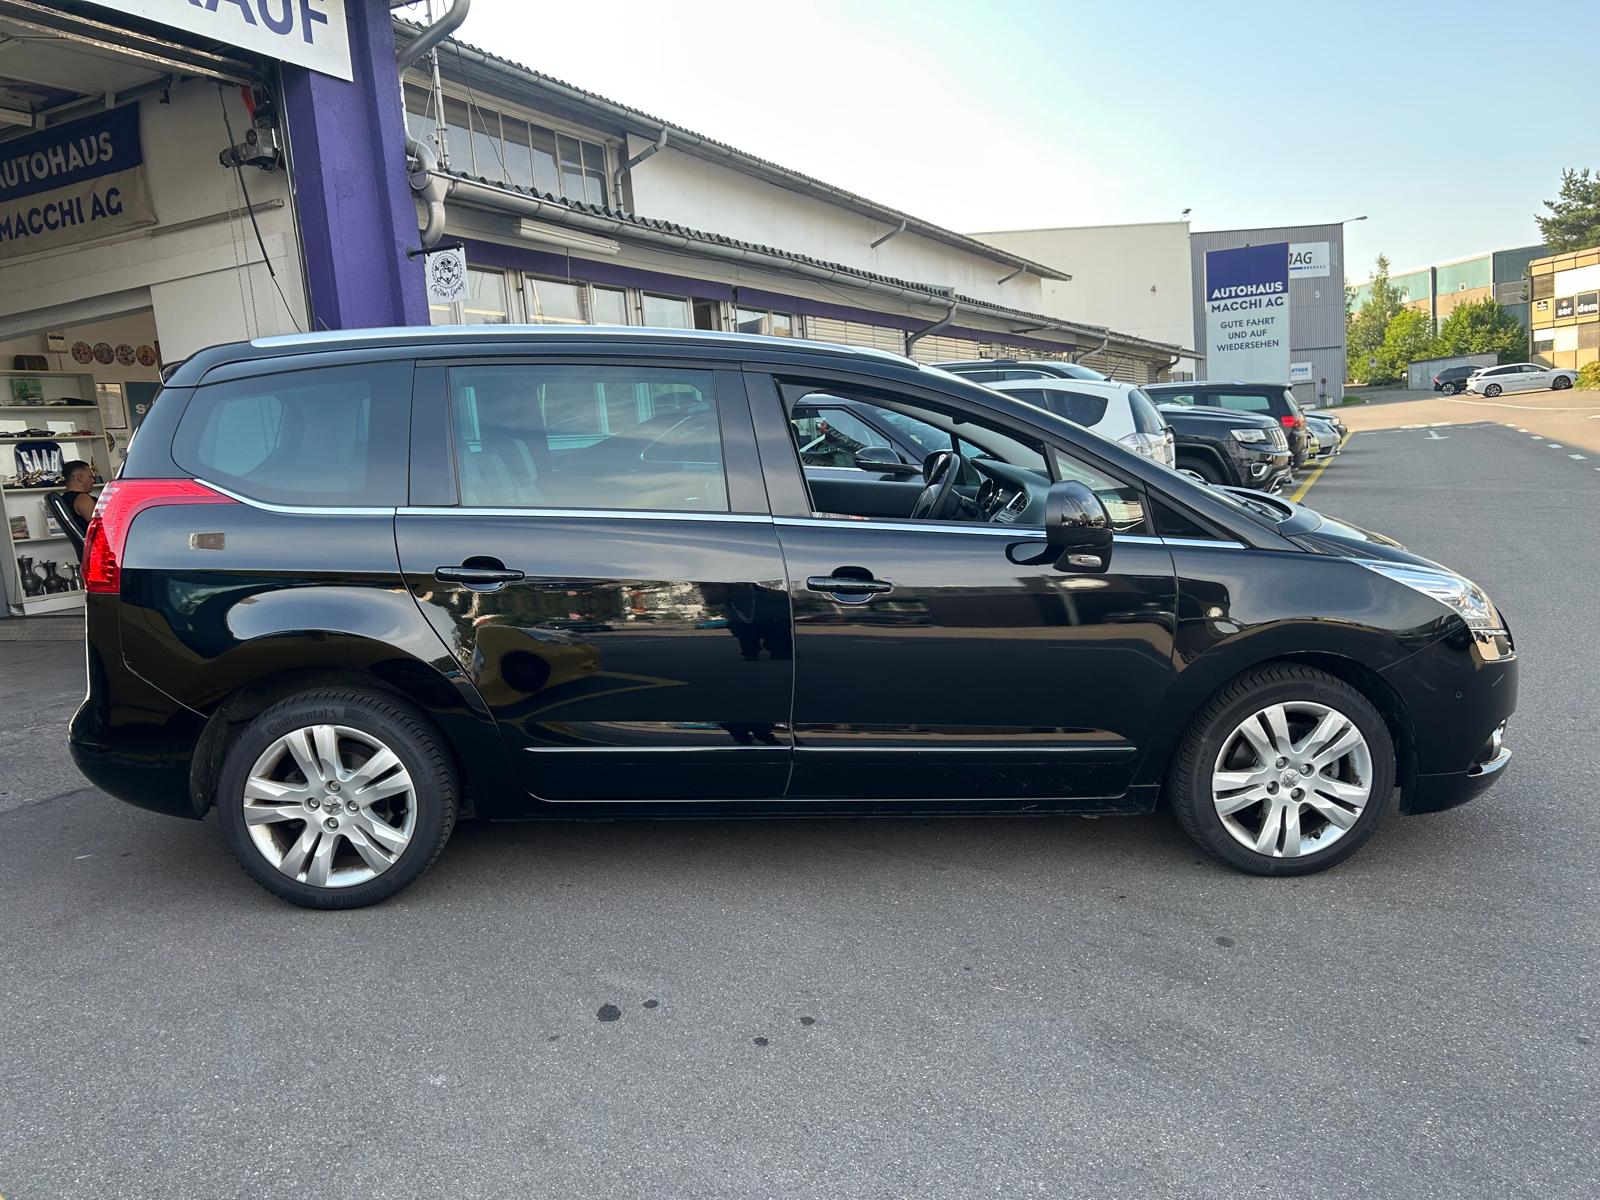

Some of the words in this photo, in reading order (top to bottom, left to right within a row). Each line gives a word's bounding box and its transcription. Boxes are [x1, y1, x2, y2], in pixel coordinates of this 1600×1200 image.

[188, 0, 328, 45] UF
[0, 197, 85, 241] MACCHI
[91, 187, 122, 221] AG
[1211, 281, 1283, 299] AUTOHAUS
[1211, 298, 1262, 313] MACCHI
[1265, 296, 1284, 308] AG
[1220, 320, 1244, 330] GUTE
[1246, 316, 1276, 327] FAHRT
[1228, 331, 1247, 340] UND
[1249, 329, 1268, 338] AUF
[1216, 339, 1280, 352] WIEDERSEHEN
[20, 448, 59, 474] SAAB
